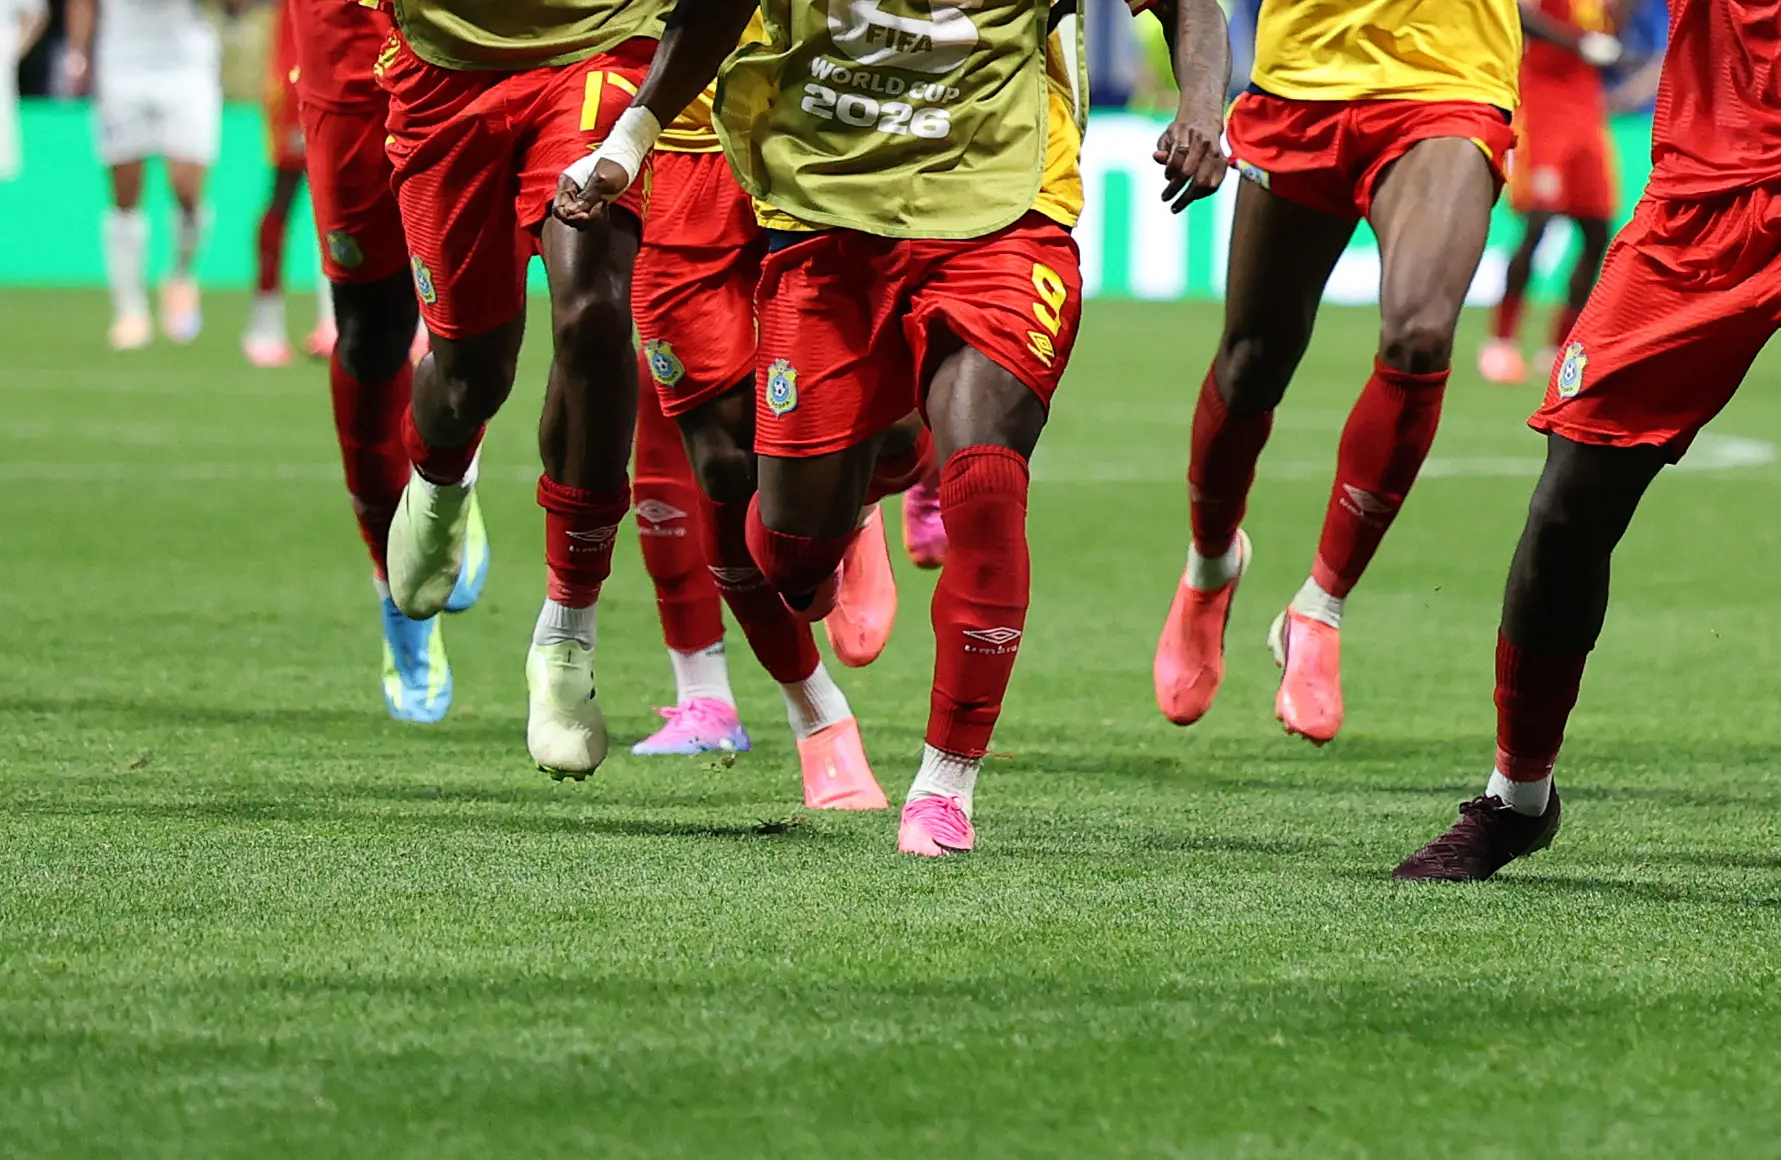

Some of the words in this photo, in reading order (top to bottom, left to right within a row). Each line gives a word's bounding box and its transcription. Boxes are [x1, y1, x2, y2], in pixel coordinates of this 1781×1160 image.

[866, 23, 933, 53] FIFA
[811, 56, 906, 95] WORLD
[909, 81, 960, 104] CUP
[801, 83, 951, 139] 2026
[1031, 262, 1067, 337] 9
